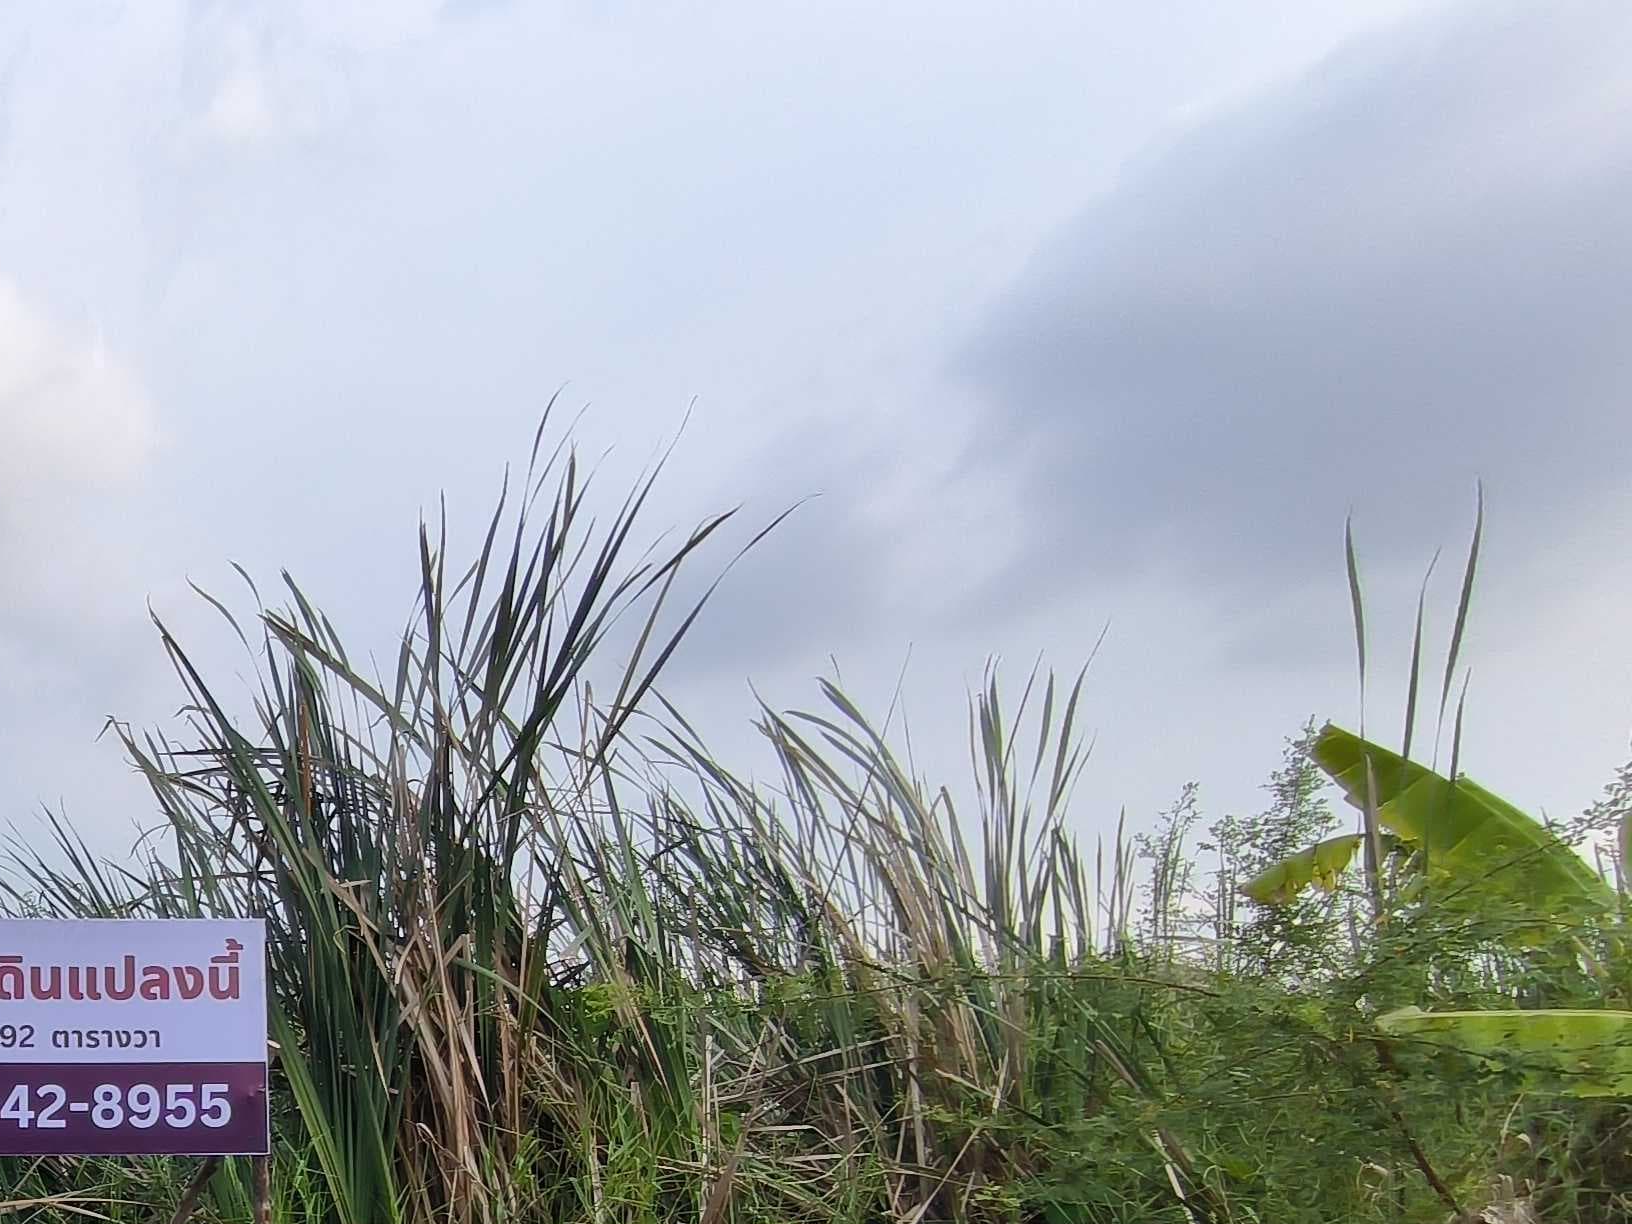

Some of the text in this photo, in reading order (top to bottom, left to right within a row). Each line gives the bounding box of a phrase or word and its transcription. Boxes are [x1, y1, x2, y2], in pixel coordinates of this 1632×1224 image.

[0, 1025, 35, 1048] 92
[52, 1027, 161, 1048] ตารางวา
